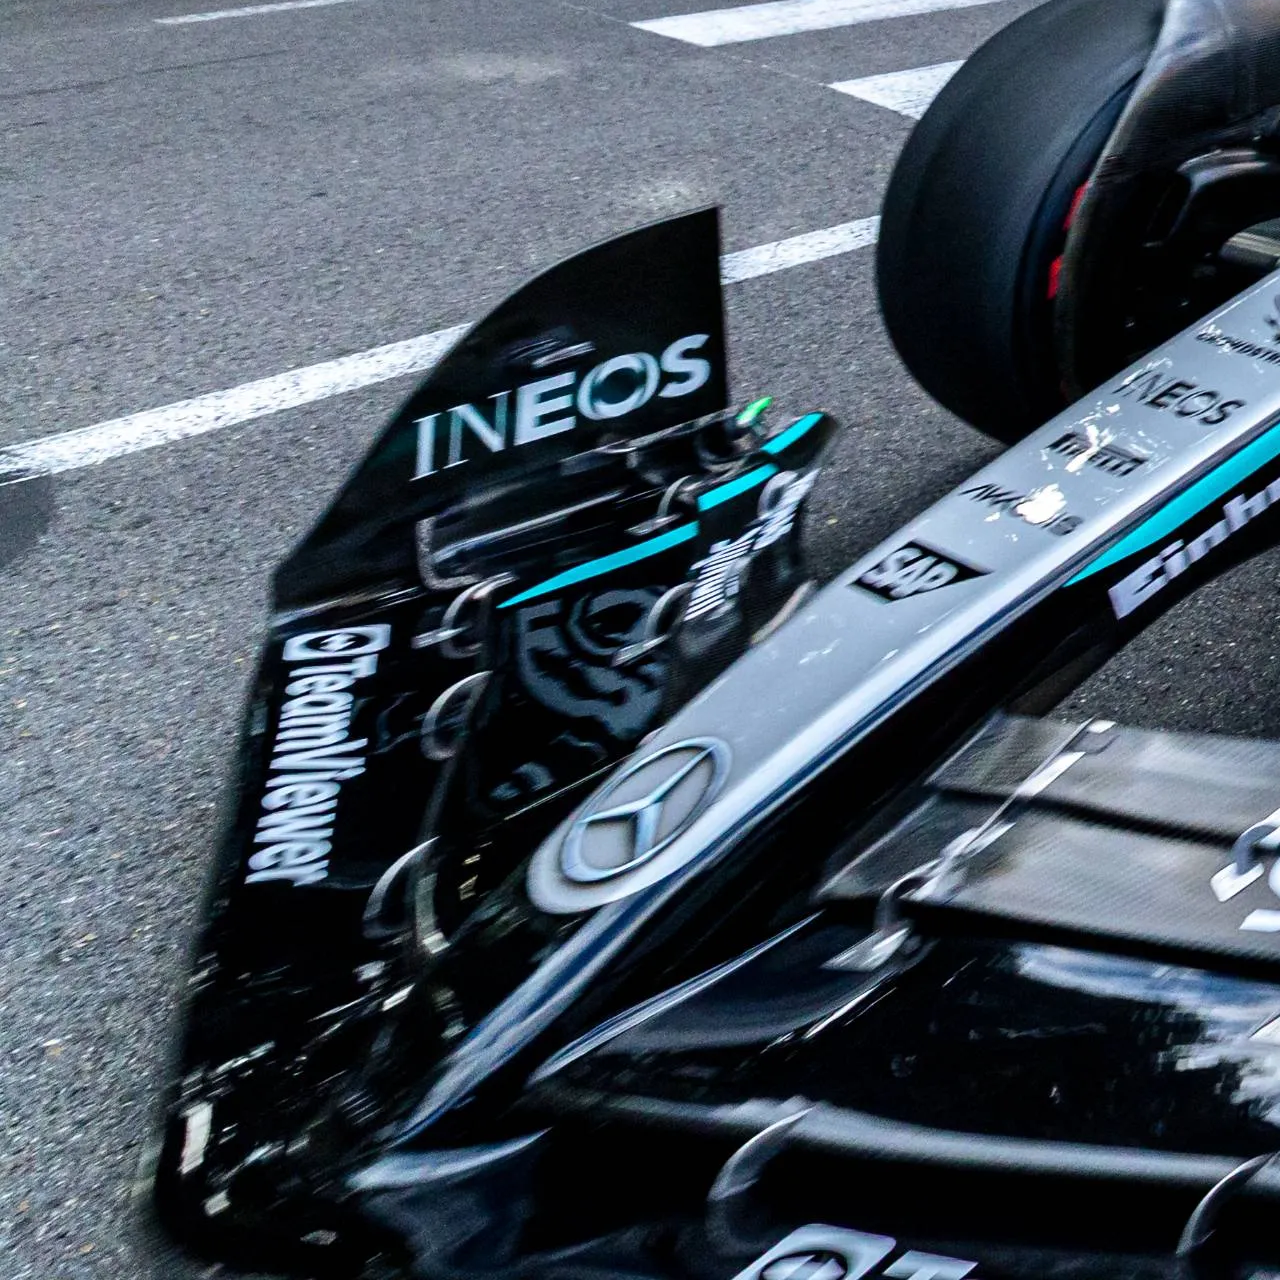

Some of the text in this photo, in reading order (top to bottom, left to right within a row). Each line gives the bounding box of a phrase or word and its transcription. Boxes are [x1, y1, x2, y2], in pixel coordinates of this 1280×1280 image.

[409, 334, 712, 481] INEOS
[1112, 369, 1248, 426] INEOS
[860, 546, 959, 599] SAP
[245, 652, 377, 887] TeamViewer
